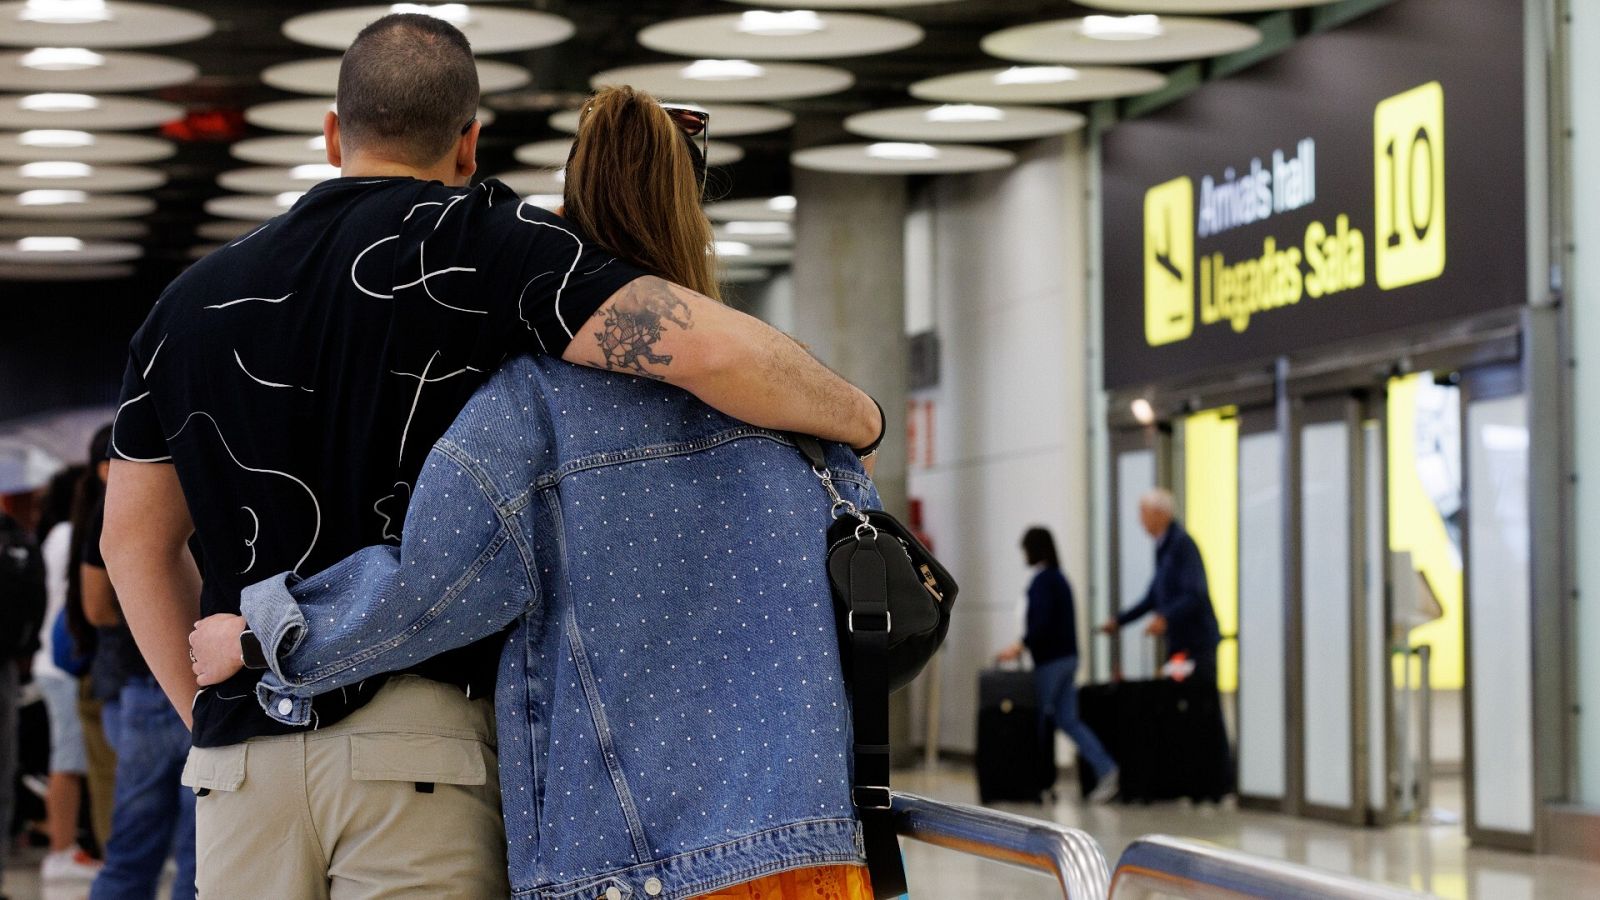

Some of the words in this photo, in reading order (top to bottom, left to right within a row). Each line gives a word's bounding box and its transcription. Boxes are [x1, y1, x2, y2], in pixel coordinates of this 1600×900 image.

[1199, 157, 1272, 237] Arrivals
[1273, 138, 1315, 213] hall
[1386, 127, 1433, 247] 10
[1201, 237, 1302, 332] Llegadas
[1305, 214, 1365, 298] Sala
